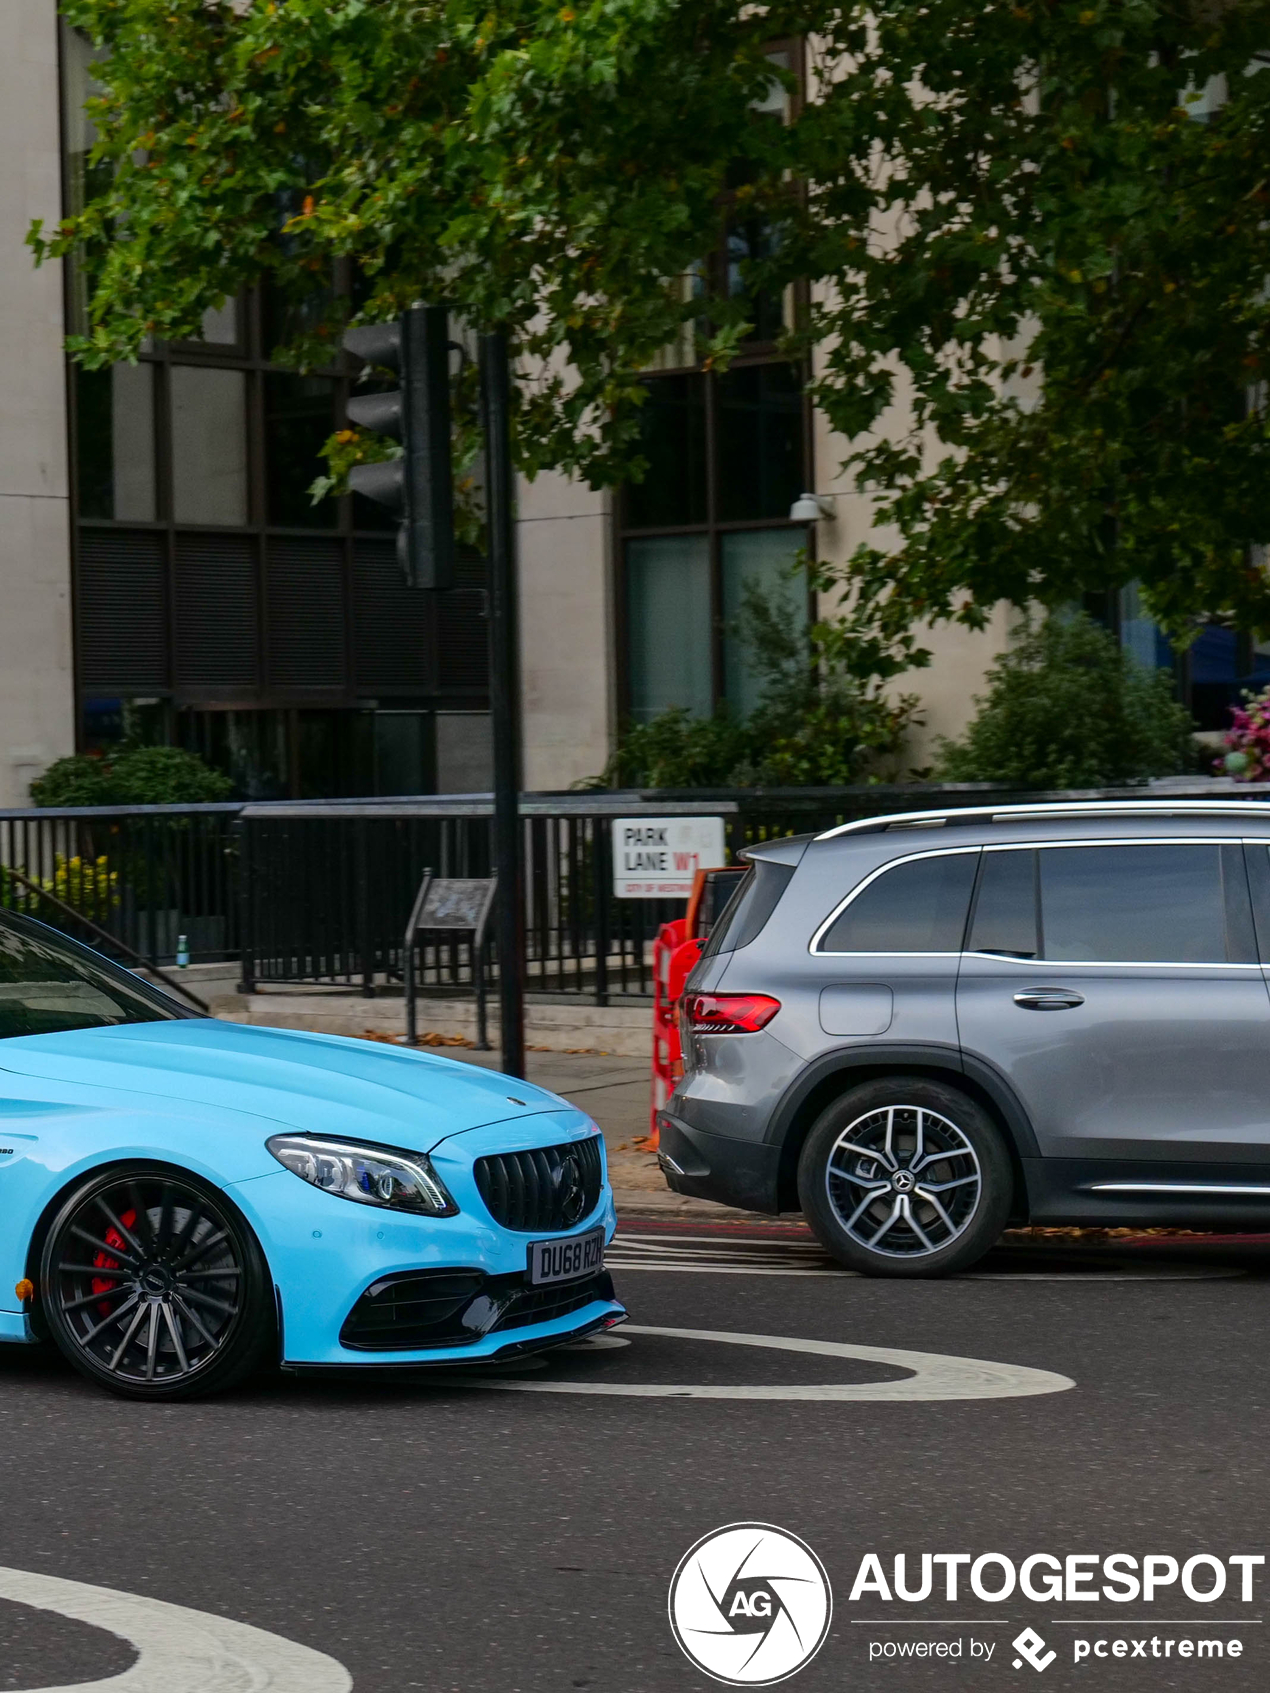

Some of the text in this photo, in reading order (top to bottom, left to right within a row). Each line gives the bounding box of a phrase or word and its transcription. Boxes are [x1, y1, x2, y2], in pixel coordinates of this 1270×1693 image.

[625, 828, 669, 846] PARK
[625, 852, 699, 870] LANE W1
[541, 1243, 581, 1278] DU68
